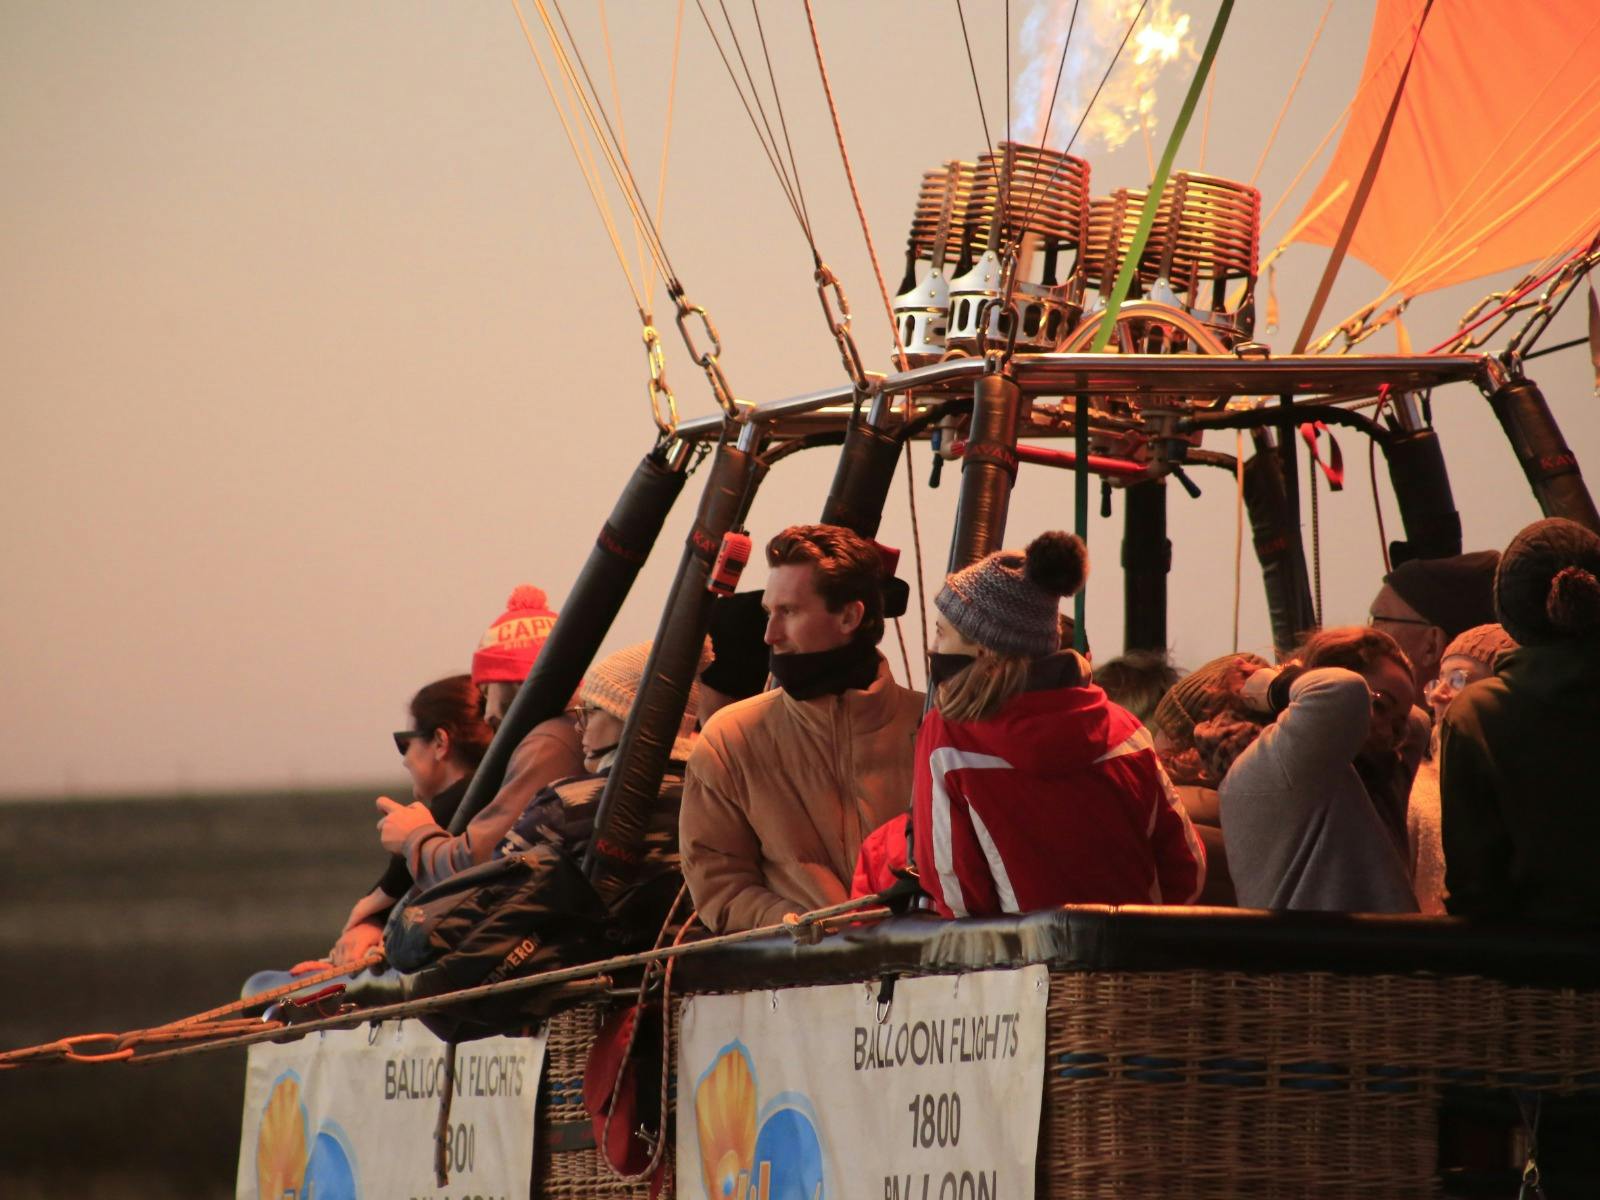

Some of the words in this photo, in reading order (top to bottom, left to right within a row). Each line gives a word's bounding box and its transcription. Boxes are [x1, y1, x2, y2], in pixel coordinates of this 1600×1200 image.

[854, 1019, 945, 1071] BALLOON
[950, 1012, 1019, 1063] FLIGHTS
[468, 1055, 526, 1097] FLIGHTS
[909, 1091, 961, 1149] 1800
[433, 1122, 475, 1174] 800
